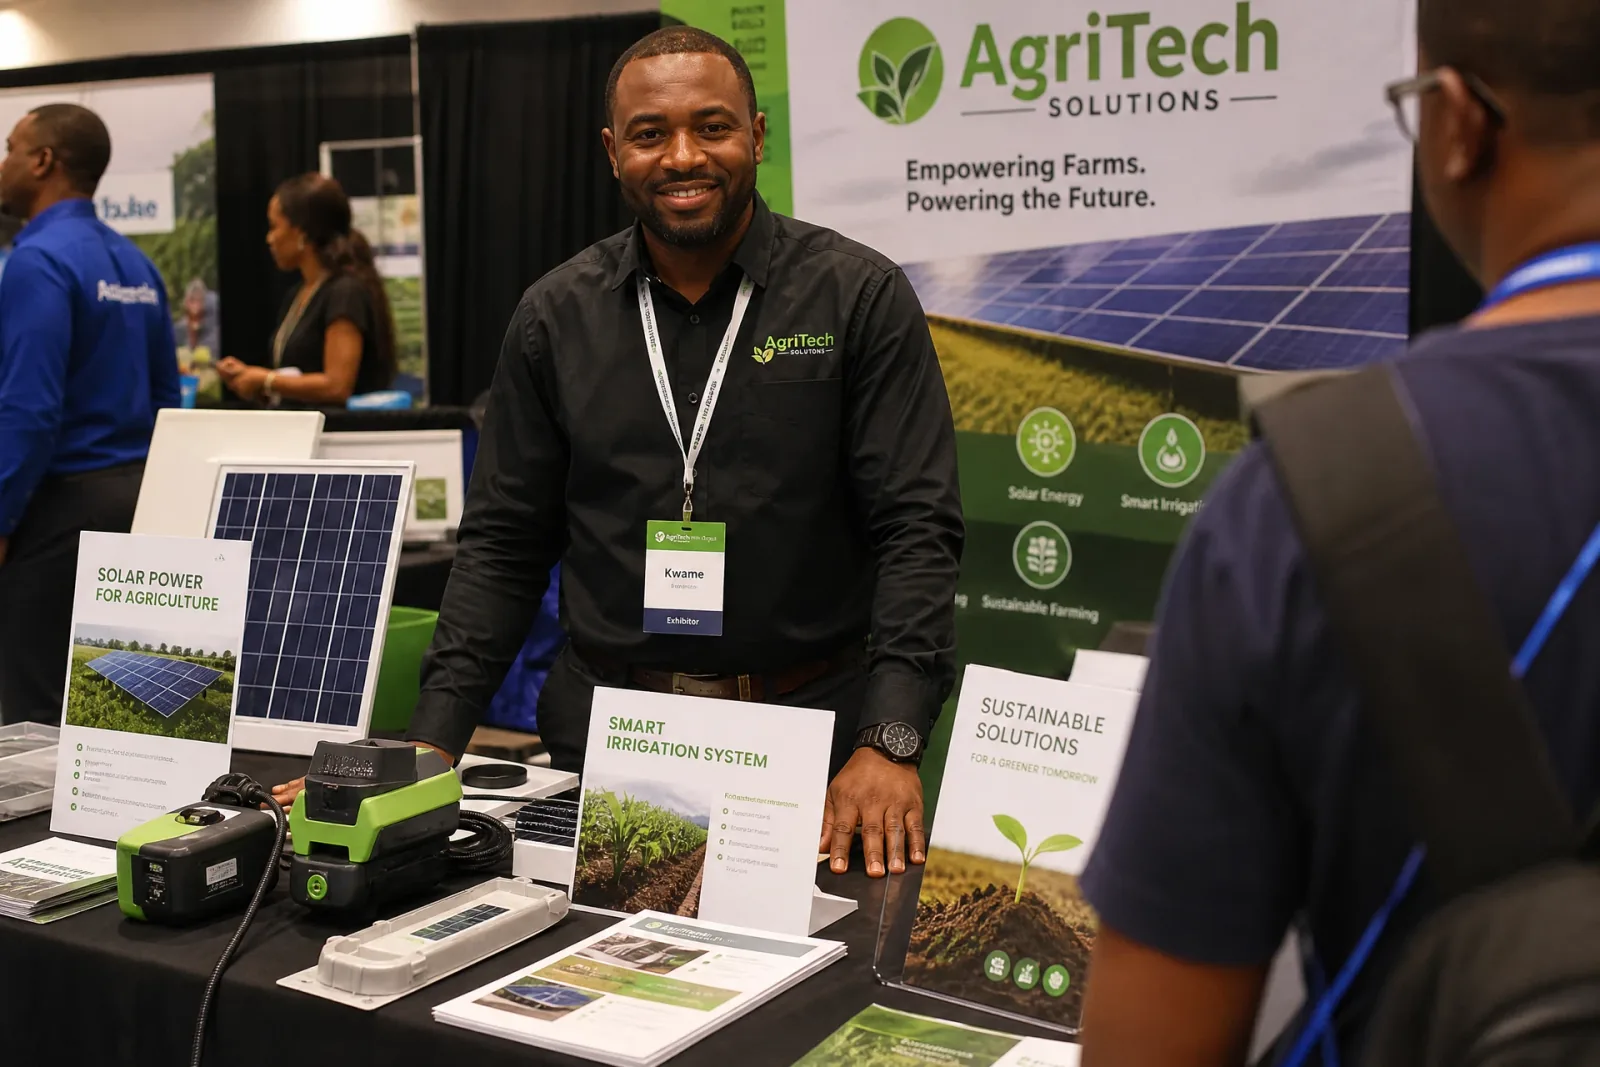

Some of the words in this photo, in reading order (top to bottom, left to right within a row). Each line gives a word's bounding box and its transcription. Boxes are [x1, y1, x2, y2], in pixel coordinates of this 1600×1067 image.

[959, 1, 1279, 101] AgriTech
[1049, 90, 1219, 118] SOLUTIONS
[906, 154, 1055, 185] Empowering
[1064, 154, 1146, 175] Farms.
[907, 188, 1015, 215] Powering
[1022, 186, 1060, 209] the
[1069, 186, 1155, 208] Future.
[764, 332, 834, 352] AgriTech
[1008, 486, 1039, 501] Solar
[1040, 487, 1083, 508] Energy
[1121, 494, 1158, 510] Smart
[98, 567, 145, 585] SOLAR
[148, 571, 203, 590] POWER
[664, 568, 704, 579] Kwame
[96, 588, 122, 603] FOR
[125, 590, 219, 611] AGRICULTURE
[981, 594, 1048, 616] Sustainable
[1050, 602, 1100, 624] Farming
[666, 616, 700, 626] Exhibitor
[608, 716, 666, 736] SMART
[980, 697, 1106, 734] SUSTAINABLE
[606, 735, 700, 760] IRRIGATION
[704, 747, 768, 768] SYSTEM
[975, 722, 1079, 756] SOLUTIONS
[970, 753, 989, 765] FOR
[998, 758, 1040, 774] GREENER
[1042, 766, 1099, 785] TOMORROW
